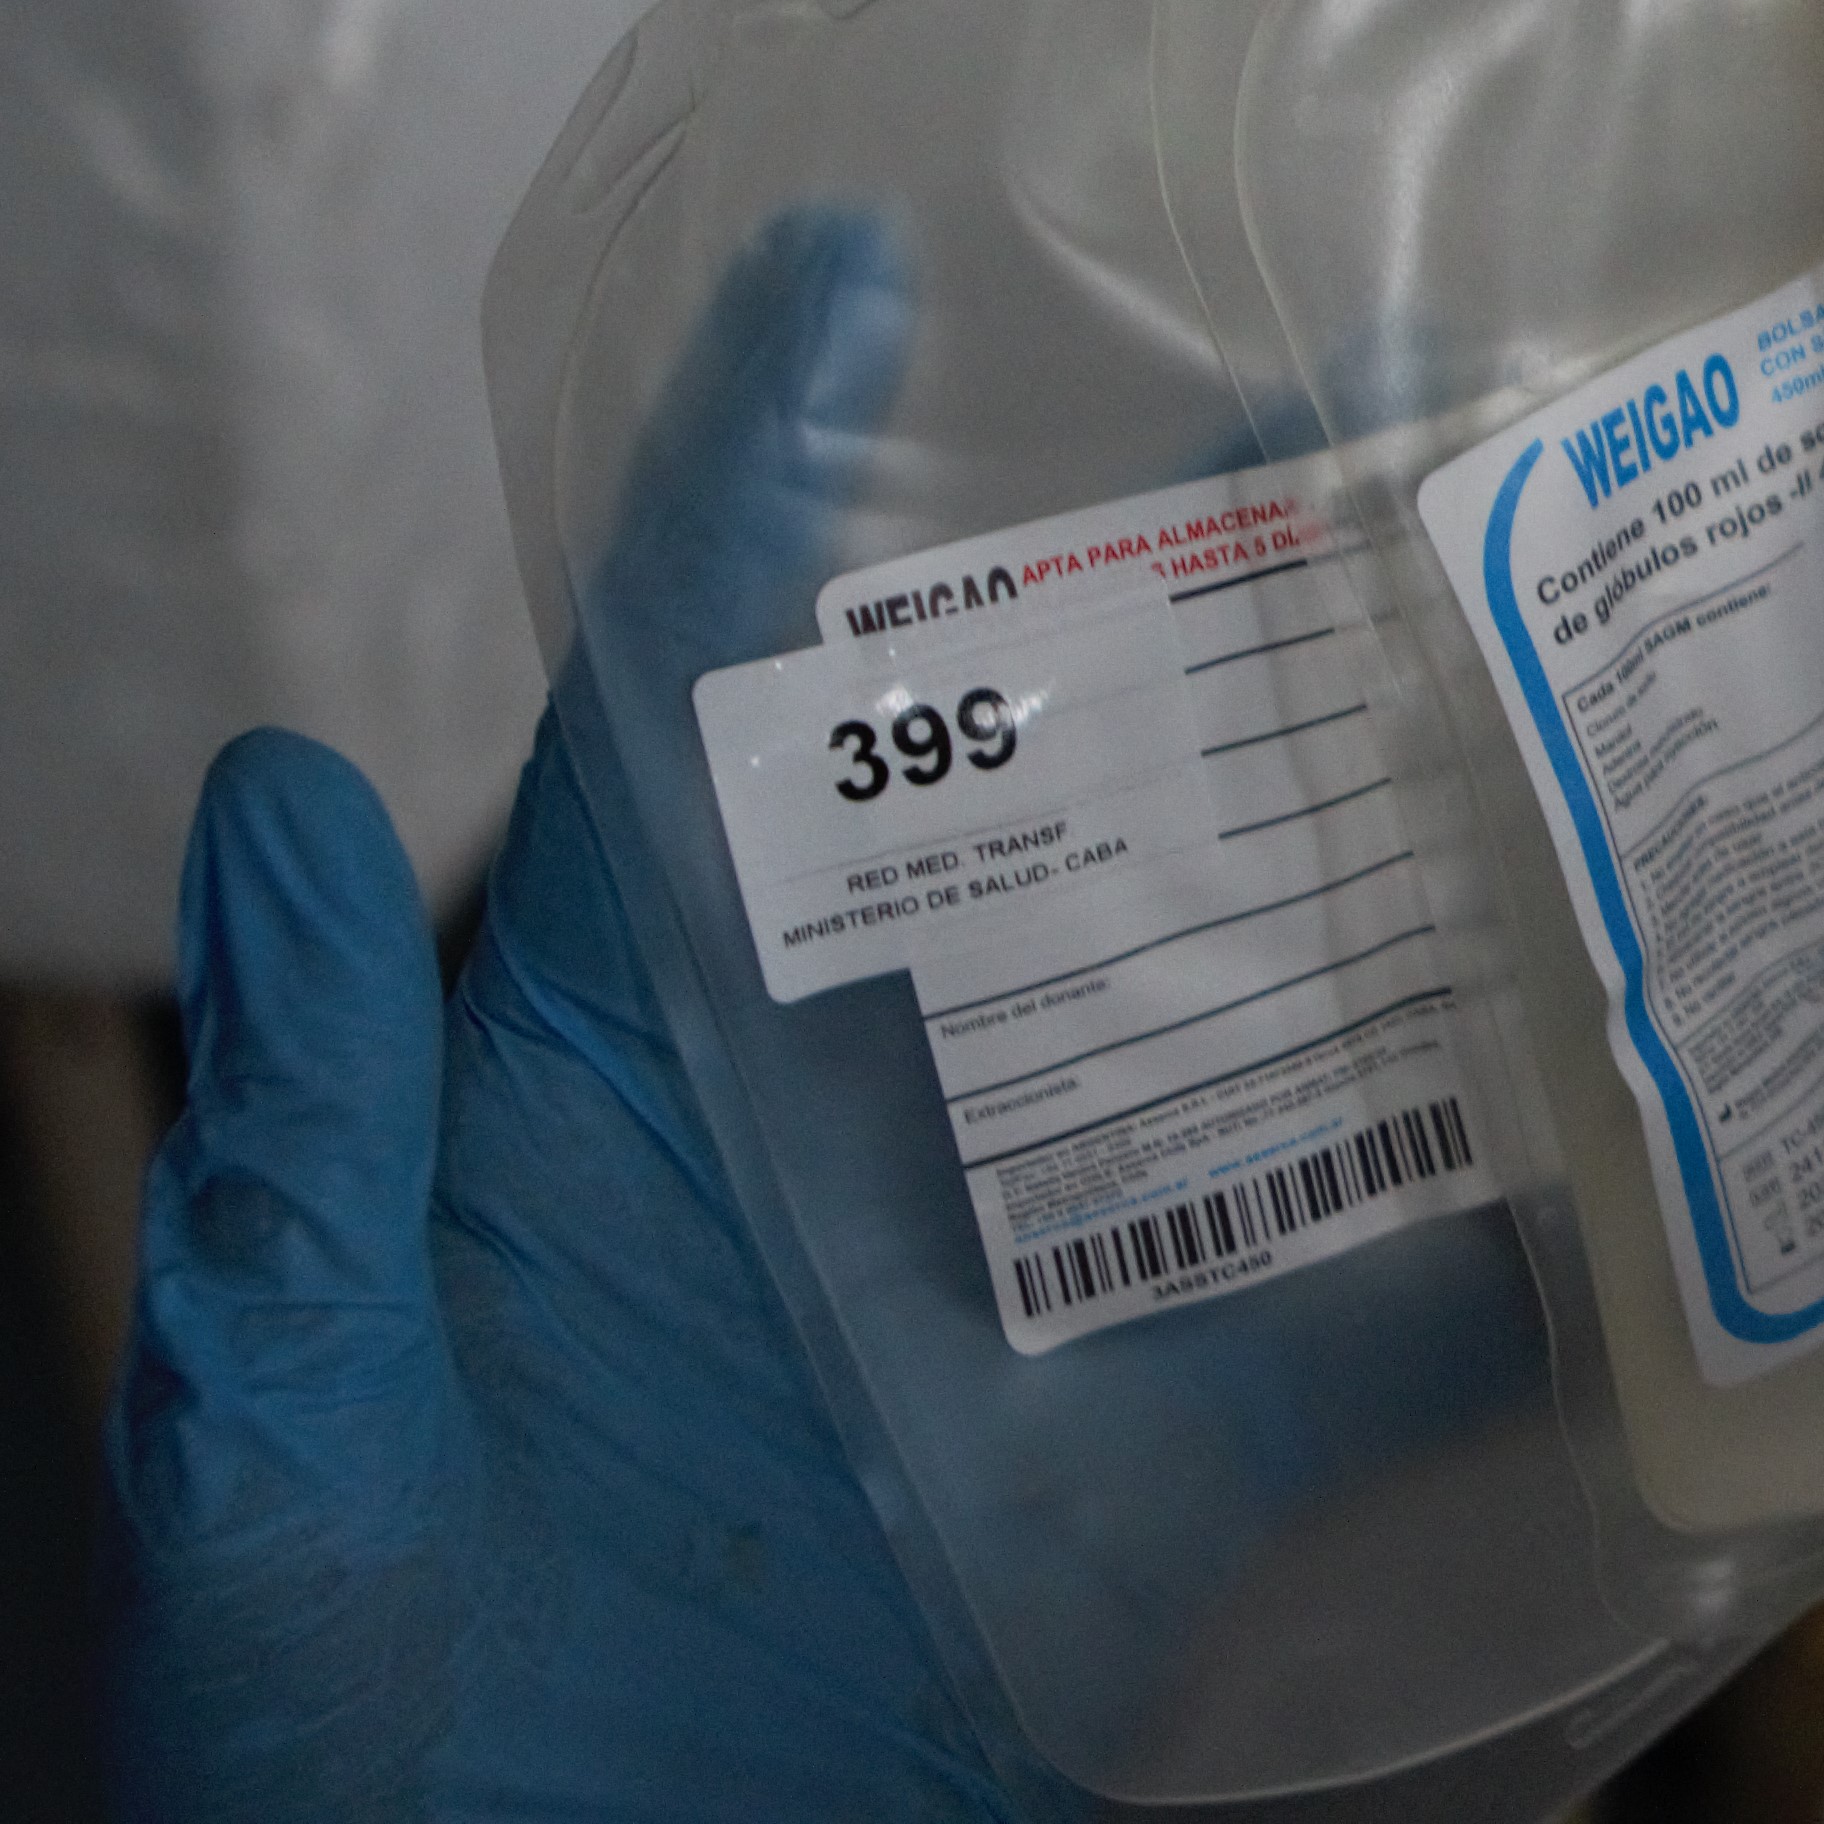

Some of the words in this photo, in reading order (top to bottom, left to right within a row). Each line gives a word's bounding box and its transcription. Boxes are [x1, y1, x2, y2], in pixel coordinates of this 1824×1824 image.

[1760, 344, 1806, 376] CON
[1561, 353, 1740, 510] WEIGAO
[1022, 554, 1083, 587] APTA
[1087, 534, 1152, 568] PARA
[1158, 499, 1301, 550] ALMACENA
[1171, 544, 1247, 579] HASTA
[1537, 518, 1646, 606] Contiene
[1651, 481, 1702, 525] 100
[1710, 459, 1750, 497] ml
[1756, 444, 1792, 475] de
[1553, 612, 1589, 646] de
[1592, 534, 1699, 626] glóbulos
[1705, 494, 1783, 547] rojos
[1577, 681, 1615, 712] Cada
[1644, 617, 1692, 654] SAGM
[828, 687, 1018, 802] 399
[782, 896, 920, 950] MINISTERIO
[926, 885, 960, 910] DE
[968, 862, 1059, 900] SALUD-
[1064, 837, 1128, 873] CABA
[847, 865, 899, 896] RED
[972, 821, 1068, 863] TRANSF
[941, 1008, 1008, 1039] Nombre
[1011, 998, 1038, 1019] del
